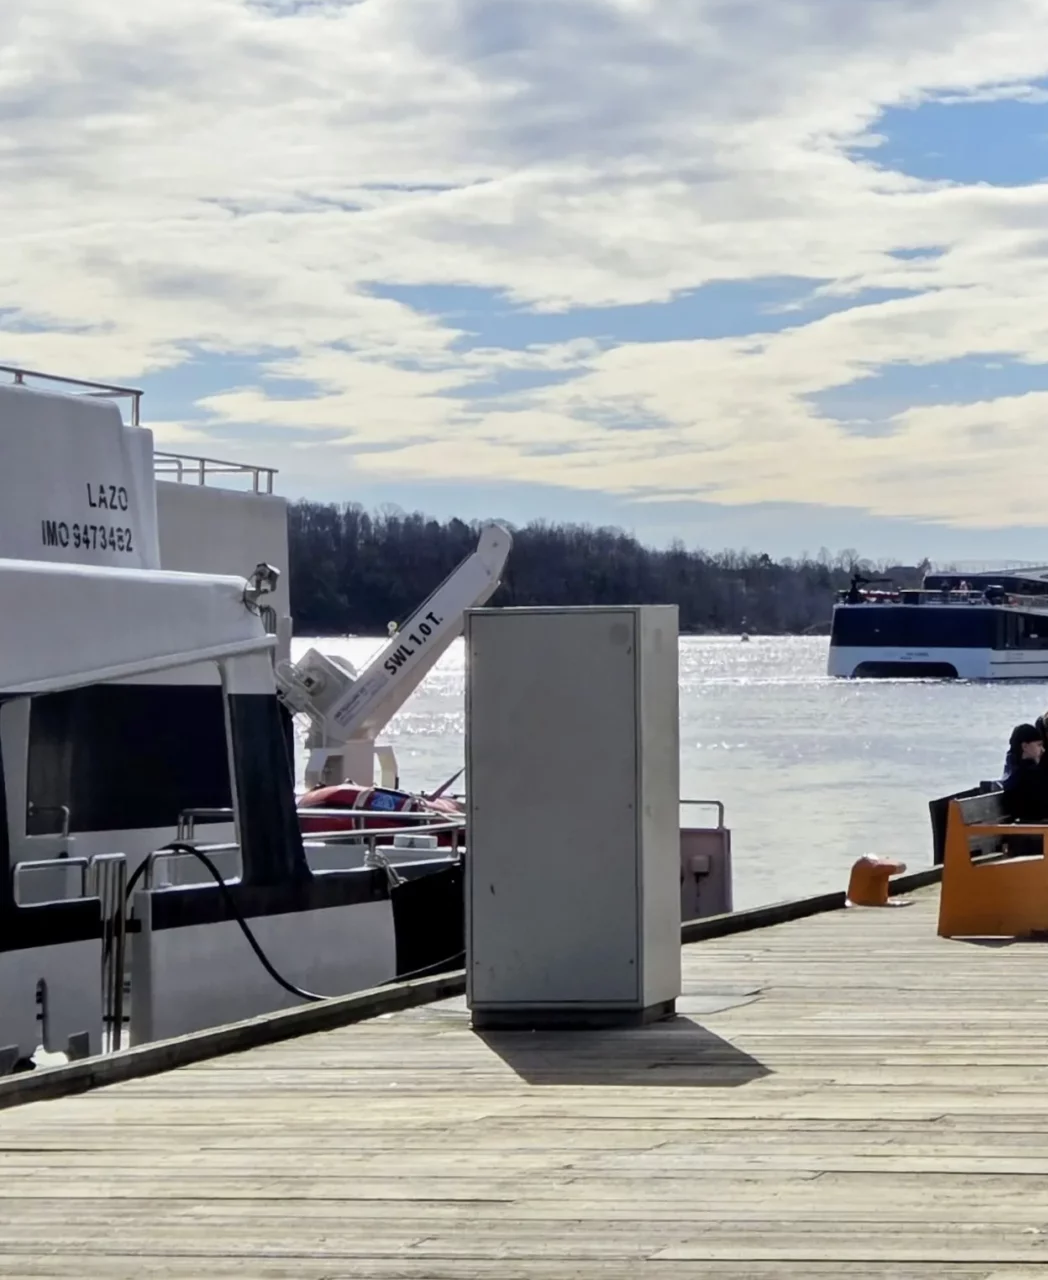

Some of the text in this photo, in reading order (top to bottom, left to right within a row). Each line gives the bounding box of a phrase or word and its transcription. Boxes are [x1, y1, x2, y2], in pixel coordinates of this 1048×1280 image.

[86, 483, 128, 511] LAZO
[41, 519, 69, 548] IMO
[384, 644, 415, 676] SWL
[409, 622, 434, 646] 1,0
